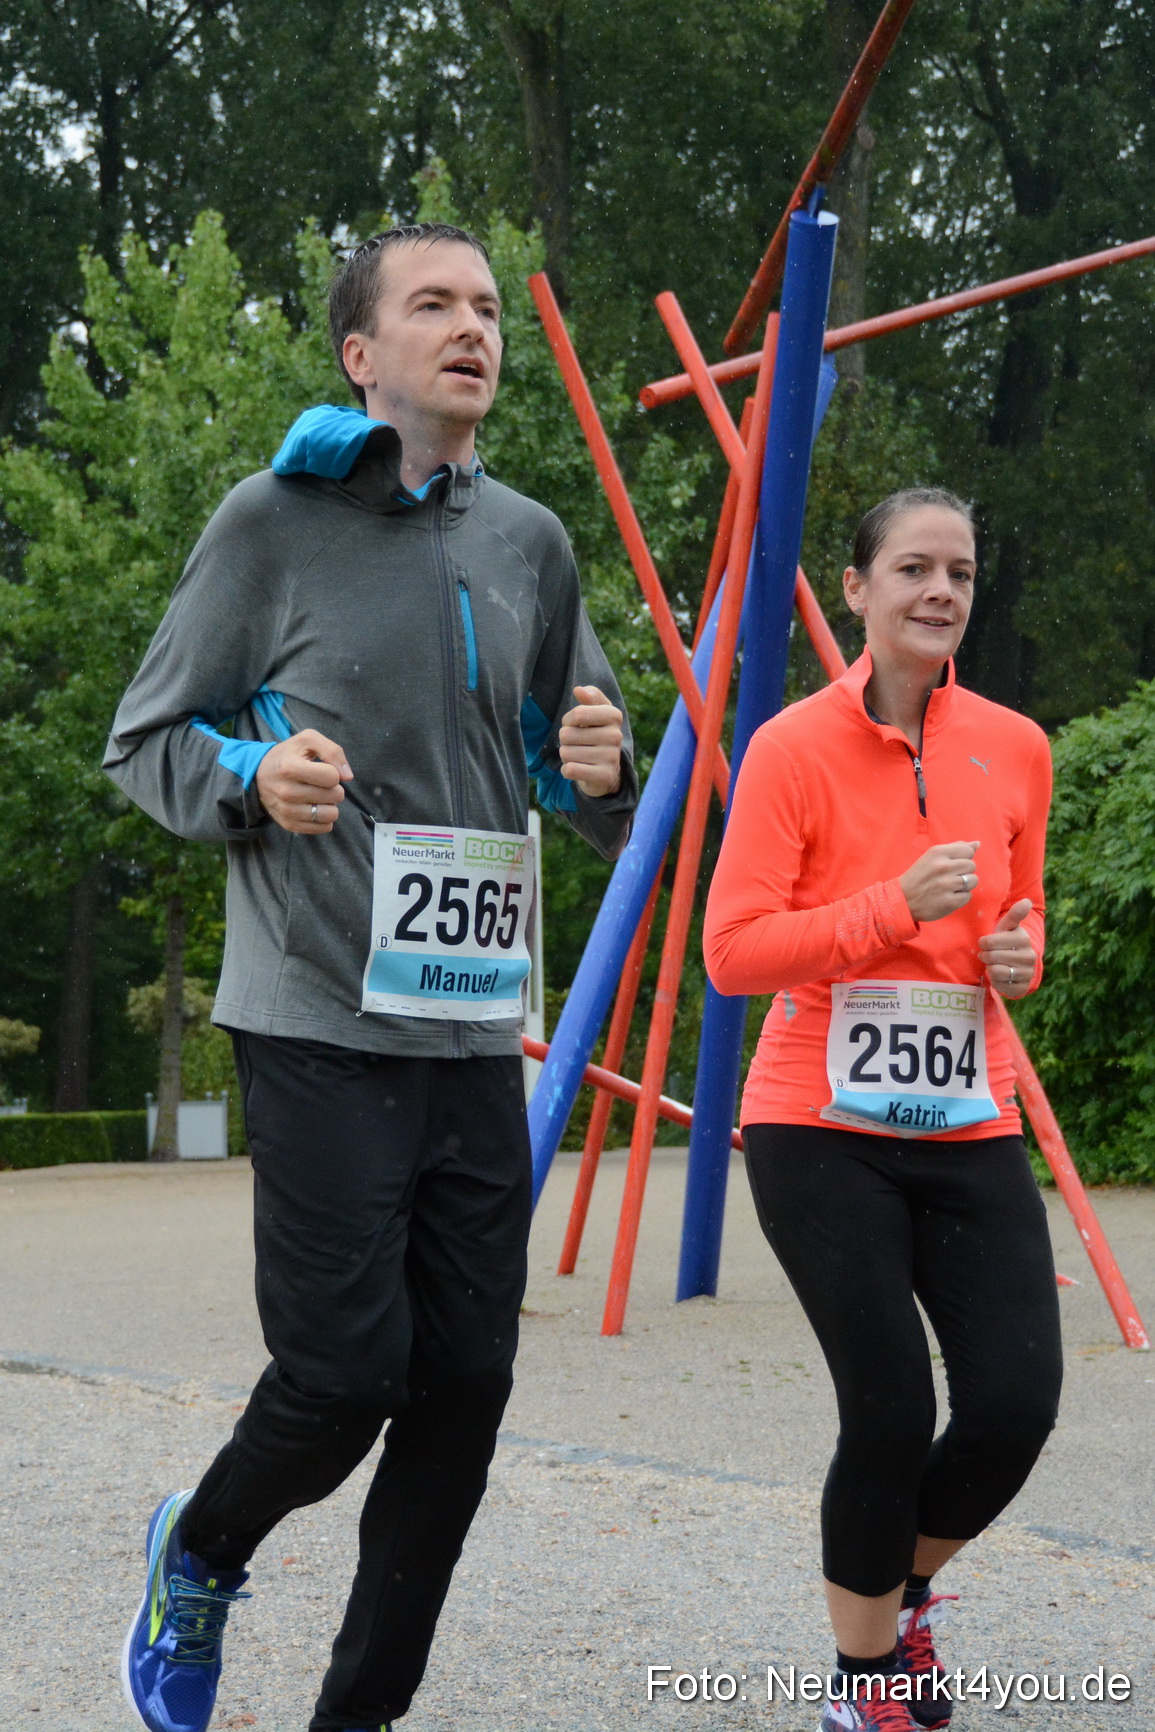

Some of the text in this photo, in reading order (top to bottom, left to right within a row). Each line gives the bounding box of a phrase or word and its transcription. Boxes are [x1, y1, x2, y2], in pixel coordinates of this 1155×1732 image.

[392, 846, 455, 861] NeuerMarkt
[465, 837, 525, 864] BOCK
[394, 872, 522, 950] 2565
[380, 936, 388, 948] D
[419, 964, 499, 993] Manuel
[844, 1000, 900, 1009] NeuerMarkt
[911, 988, 977, 1012] BOCK
[848, 1022, 977, 1089] 2564
[836, 1078, 844, 1087] D
[885, 1101, 949, 1128] Katrin
